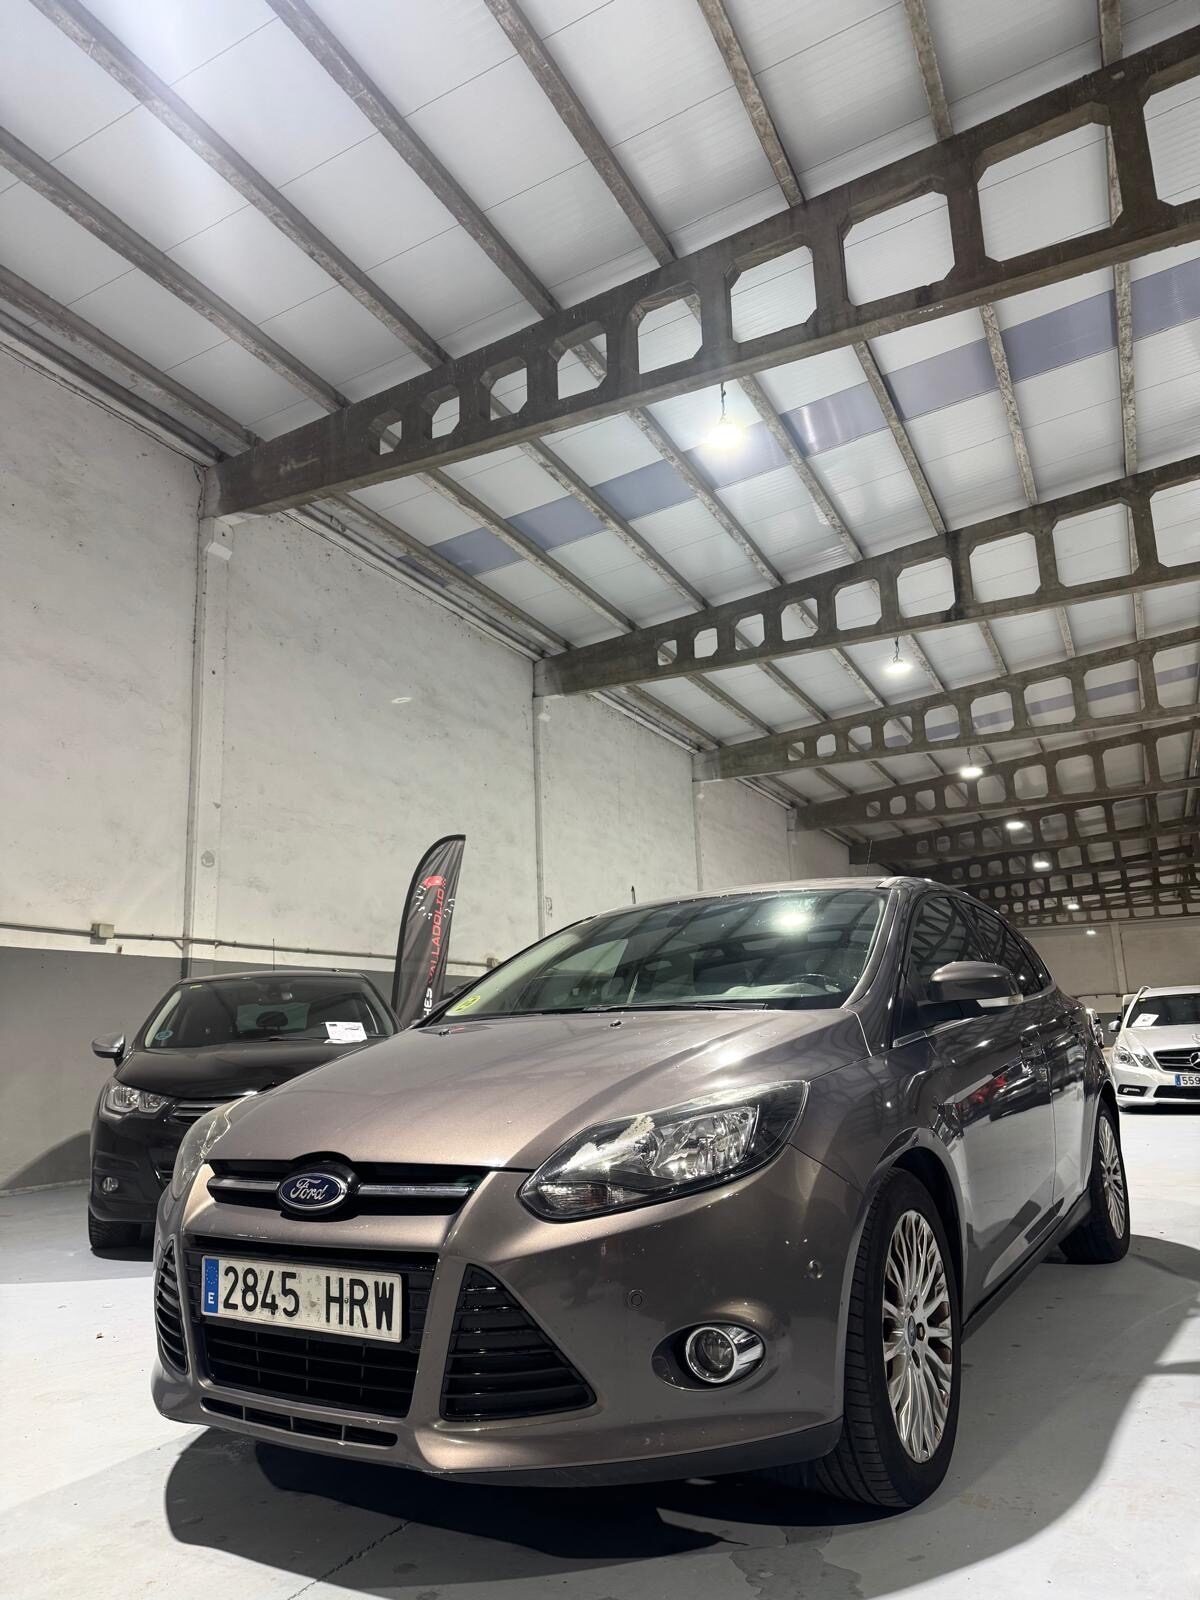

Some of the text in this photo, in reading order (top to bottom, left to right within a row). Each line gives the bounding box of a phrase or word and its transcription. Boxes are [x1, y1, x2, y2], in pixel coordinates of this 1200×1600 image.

[289, 1177, 328, 1201] Ford
[208, 1292, 215, 1304] E
[222, 1265, 394, 1331] 2845 HRW
